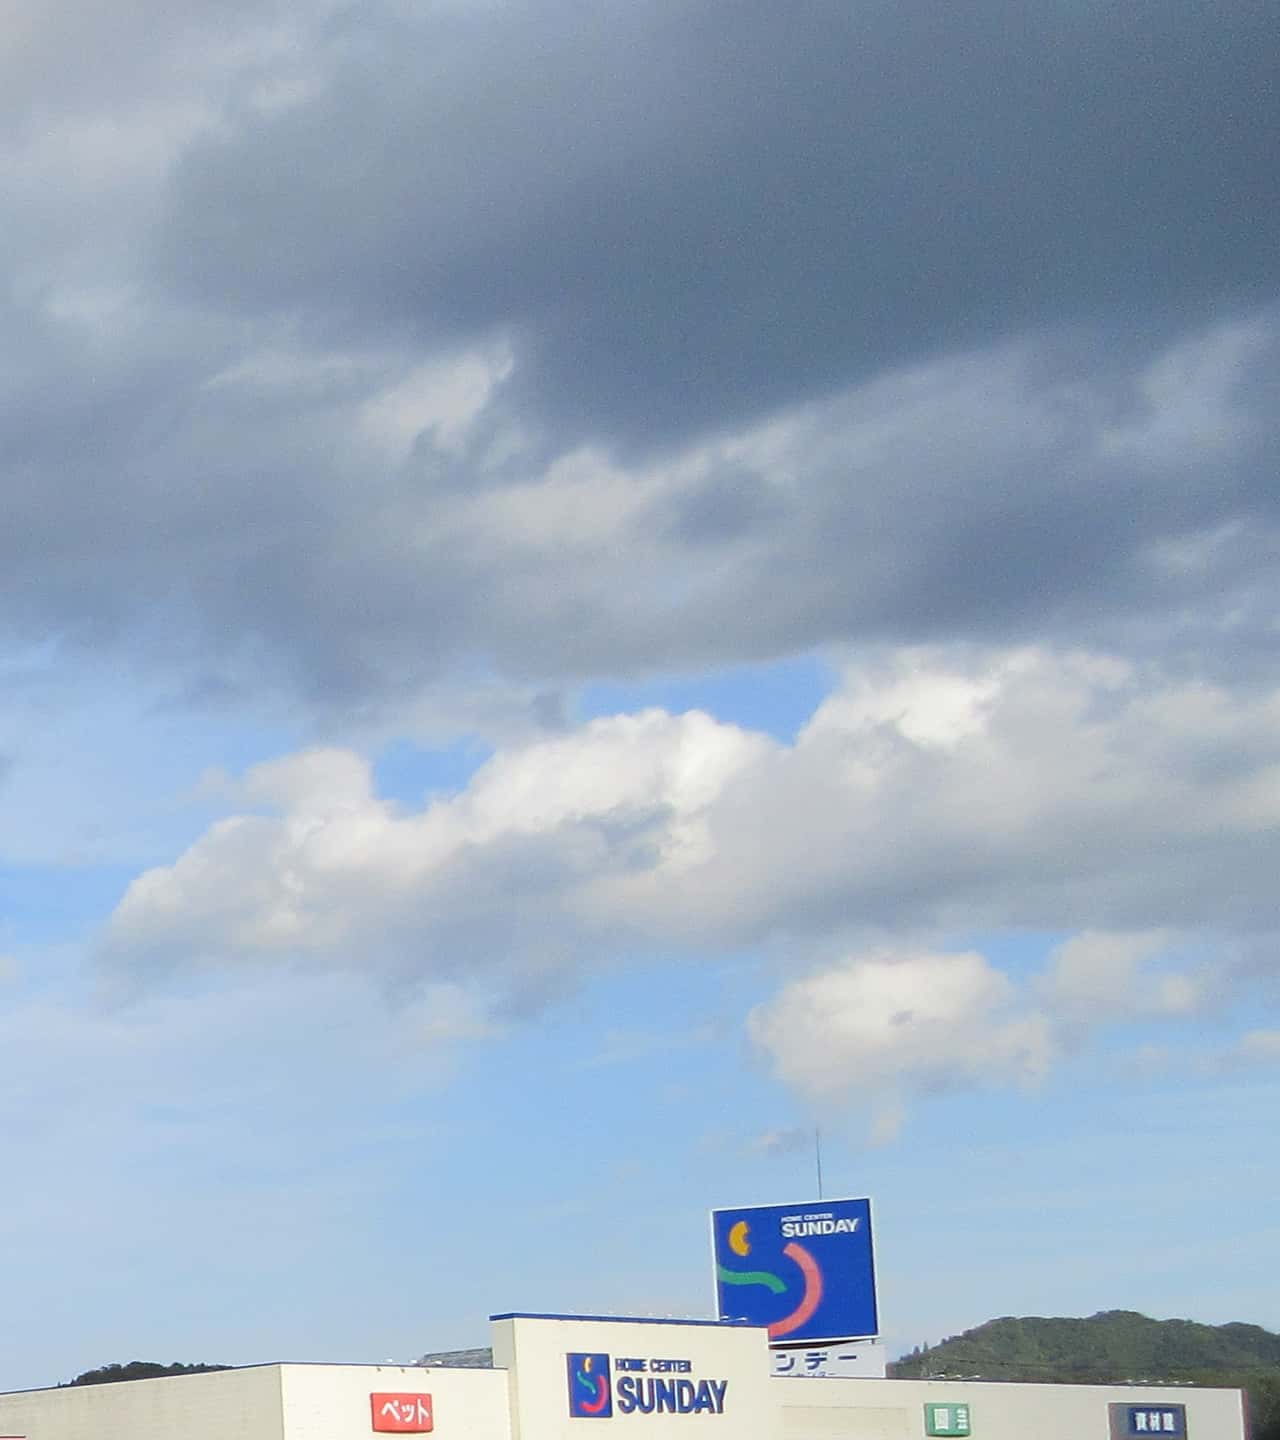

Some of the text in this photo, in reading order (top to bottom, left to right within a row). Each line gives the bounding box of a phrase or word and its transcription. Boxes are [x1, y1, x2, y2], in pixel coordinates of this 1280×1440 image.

[782, 1217, 859, 1238] SUNDAY
[617, 1376, 729, 1414] SUNDAY
[381, 1398, 429, 1425] ペット
